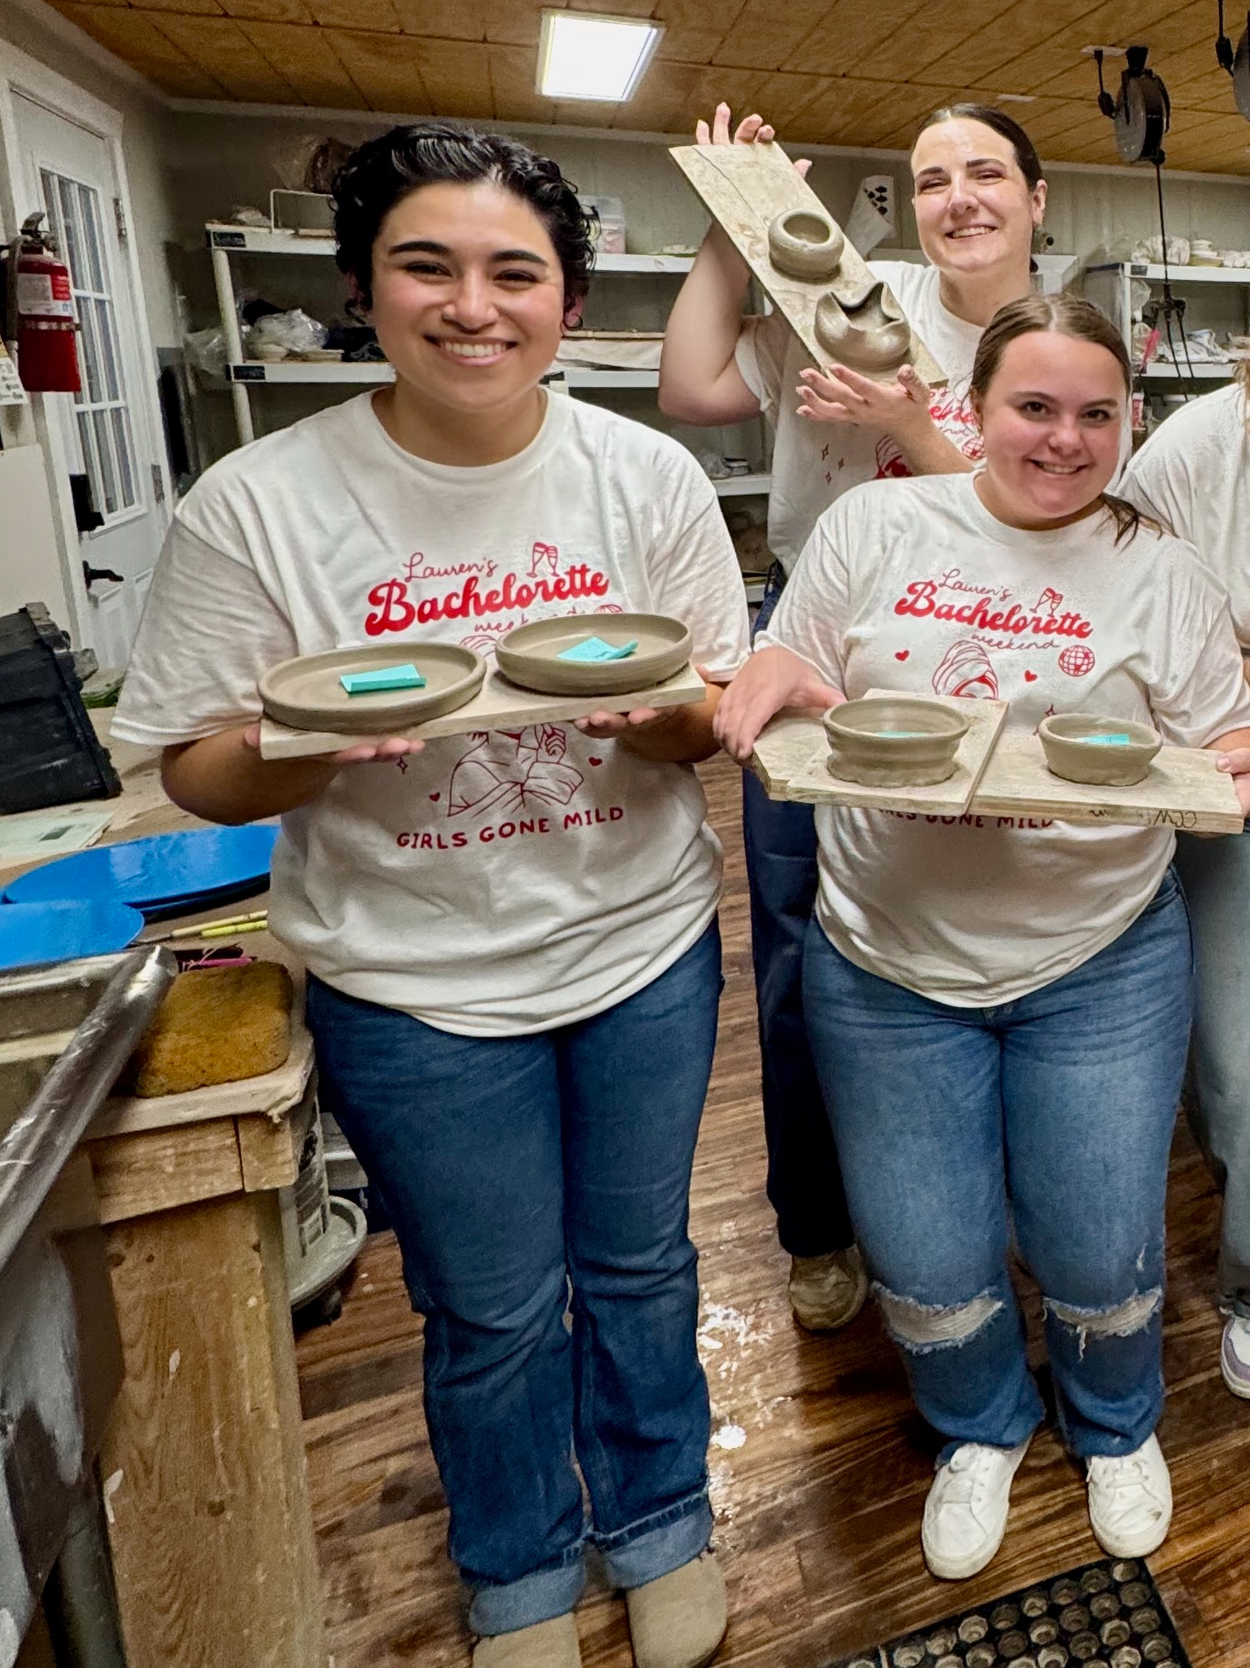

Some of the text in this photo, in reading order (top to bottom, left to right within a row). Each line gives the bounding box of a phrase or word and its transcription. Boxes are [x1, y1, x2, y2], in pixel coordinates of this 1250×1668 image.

[403, 551, 498, 583] Lauren's
[937, 568, 1013, 601] Lauren's
[364, 563, 611, 637] Bachelorette
[893, 579, 1094, 639] Bachelorette
[971, 630, 1062, 651] weekend
[396, 806, 625, 851] GIRLS GONE MILD
